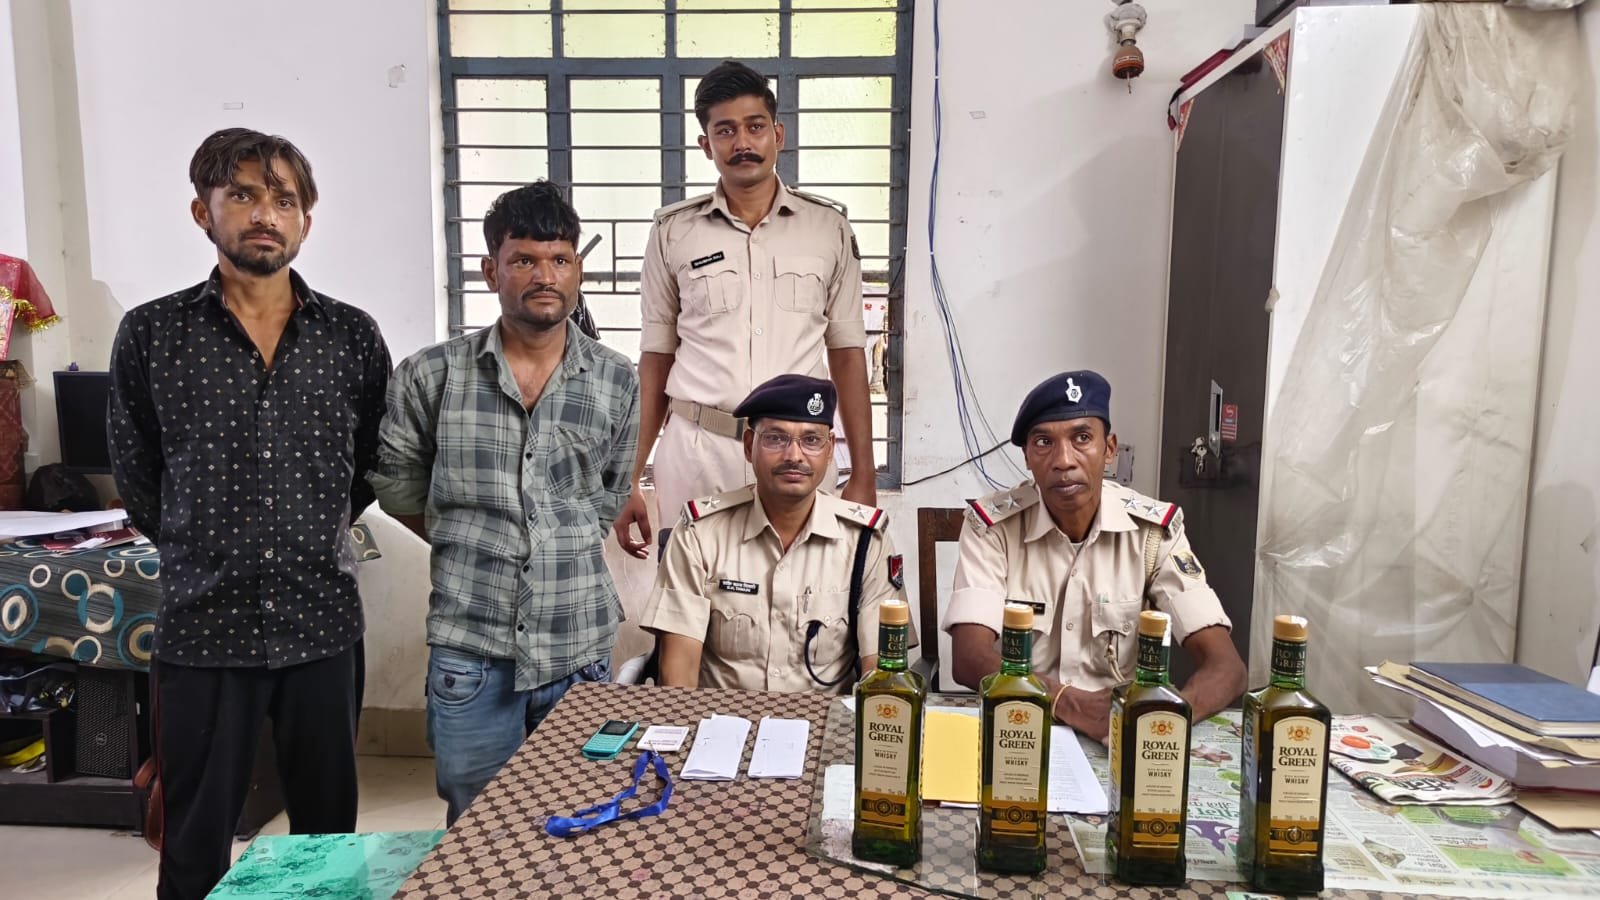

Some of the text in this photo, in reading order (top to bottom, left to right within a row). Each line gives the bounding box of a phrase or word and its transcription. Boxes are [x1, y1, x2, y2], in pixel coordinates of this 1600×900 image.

[869, 722, 904, 734] ROYAL
[869, 731, 903, 744] GREEN
[1000, 729, 1036, 740] ROYAL
[999, 739, 1035, 749] GREEN
[1143, 741, 1180, 750] ROYAL
[875, 752, 897, 760] WHISKY
[1142, 750, 1179, 760] GREEN
[1280, 747, 1317, 756] ROYAL
[1279, 756, 1317, 767] GREEN
